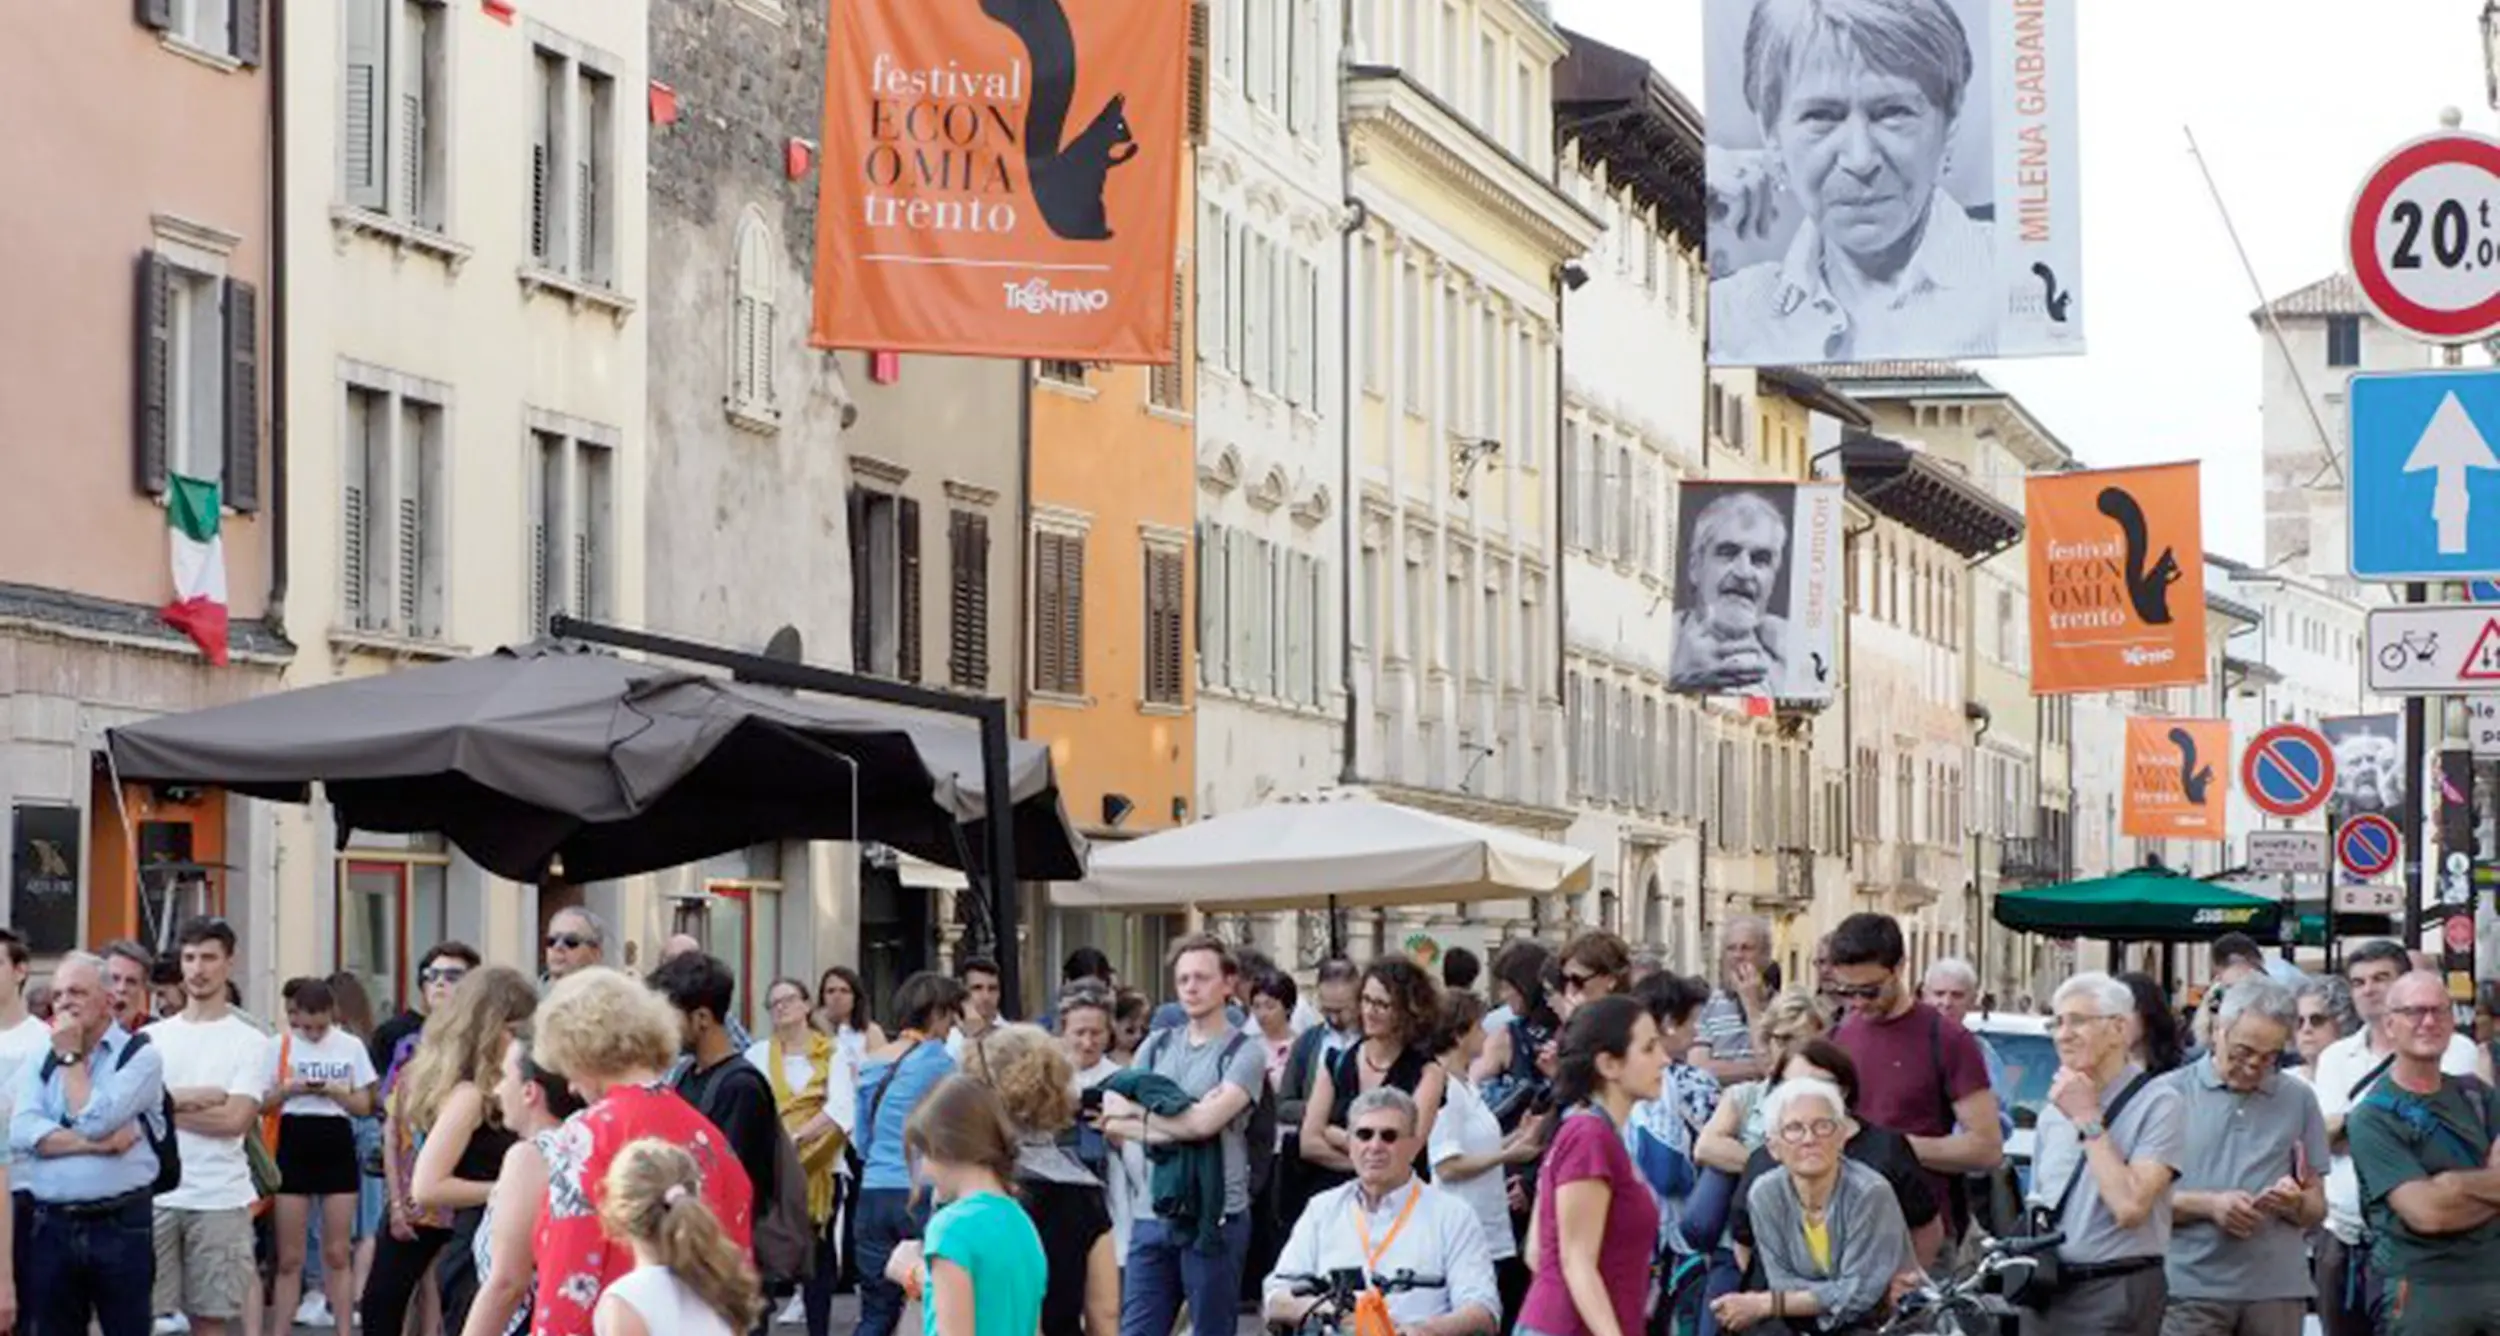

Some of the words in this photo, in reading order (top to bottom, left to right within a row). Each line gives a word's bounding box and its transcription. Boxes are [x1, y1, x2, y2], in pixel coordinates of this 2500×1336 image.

[872, 54, 1021, 100] festival
[871, 100, 1019, 146] ECON
[865, 147, 1015, 193] OMIA
[2018, 124, 2050, 243] MILENA
[863, 194, 1017, 234] trento
[2048, 538, 2122, 562] festival
[2049, 559, 2121, 585] ECON
[2049, 608, 2125, 630] trento
